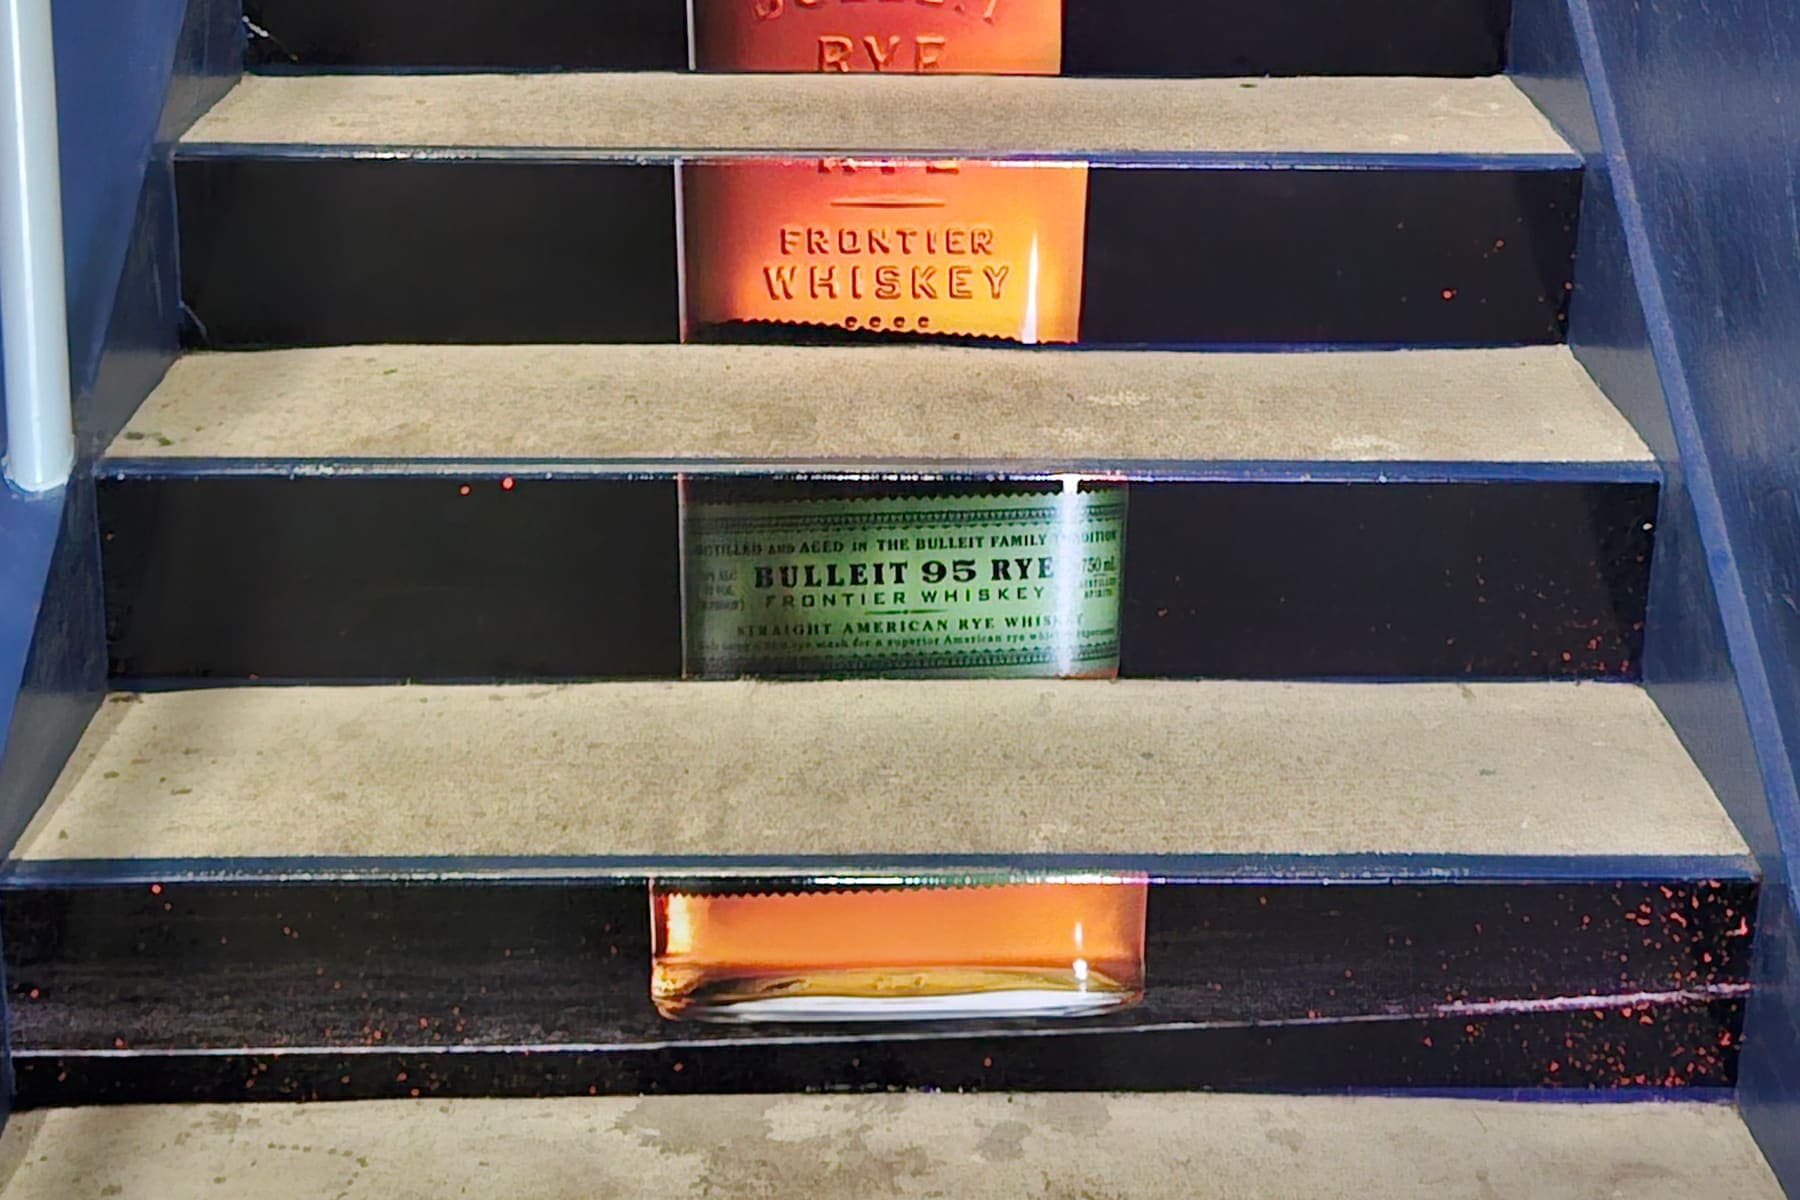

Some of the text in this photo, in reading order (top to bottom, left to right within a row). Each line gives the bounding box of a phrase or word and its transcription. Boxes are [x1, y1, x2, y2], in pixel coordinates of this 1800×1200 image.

[780, 228, 994, 256] FRONTIER
[763, 265, 1011, 300] WHISKEY
[800, 540, 844, 553] AGED
[877, 538, 909, 551] THE
[916, 536, 984, 550] BULLEIT
[991, 534, 1047, 548] FAMILY
[754, 557, 1054, 588] BULLEIT 95 RYE
[765, 587, 1045, 609] FRONTIER WHISKEY
[843, 619, 948, 634] AMERICAN
[958, 617, 994, 631] RYE
